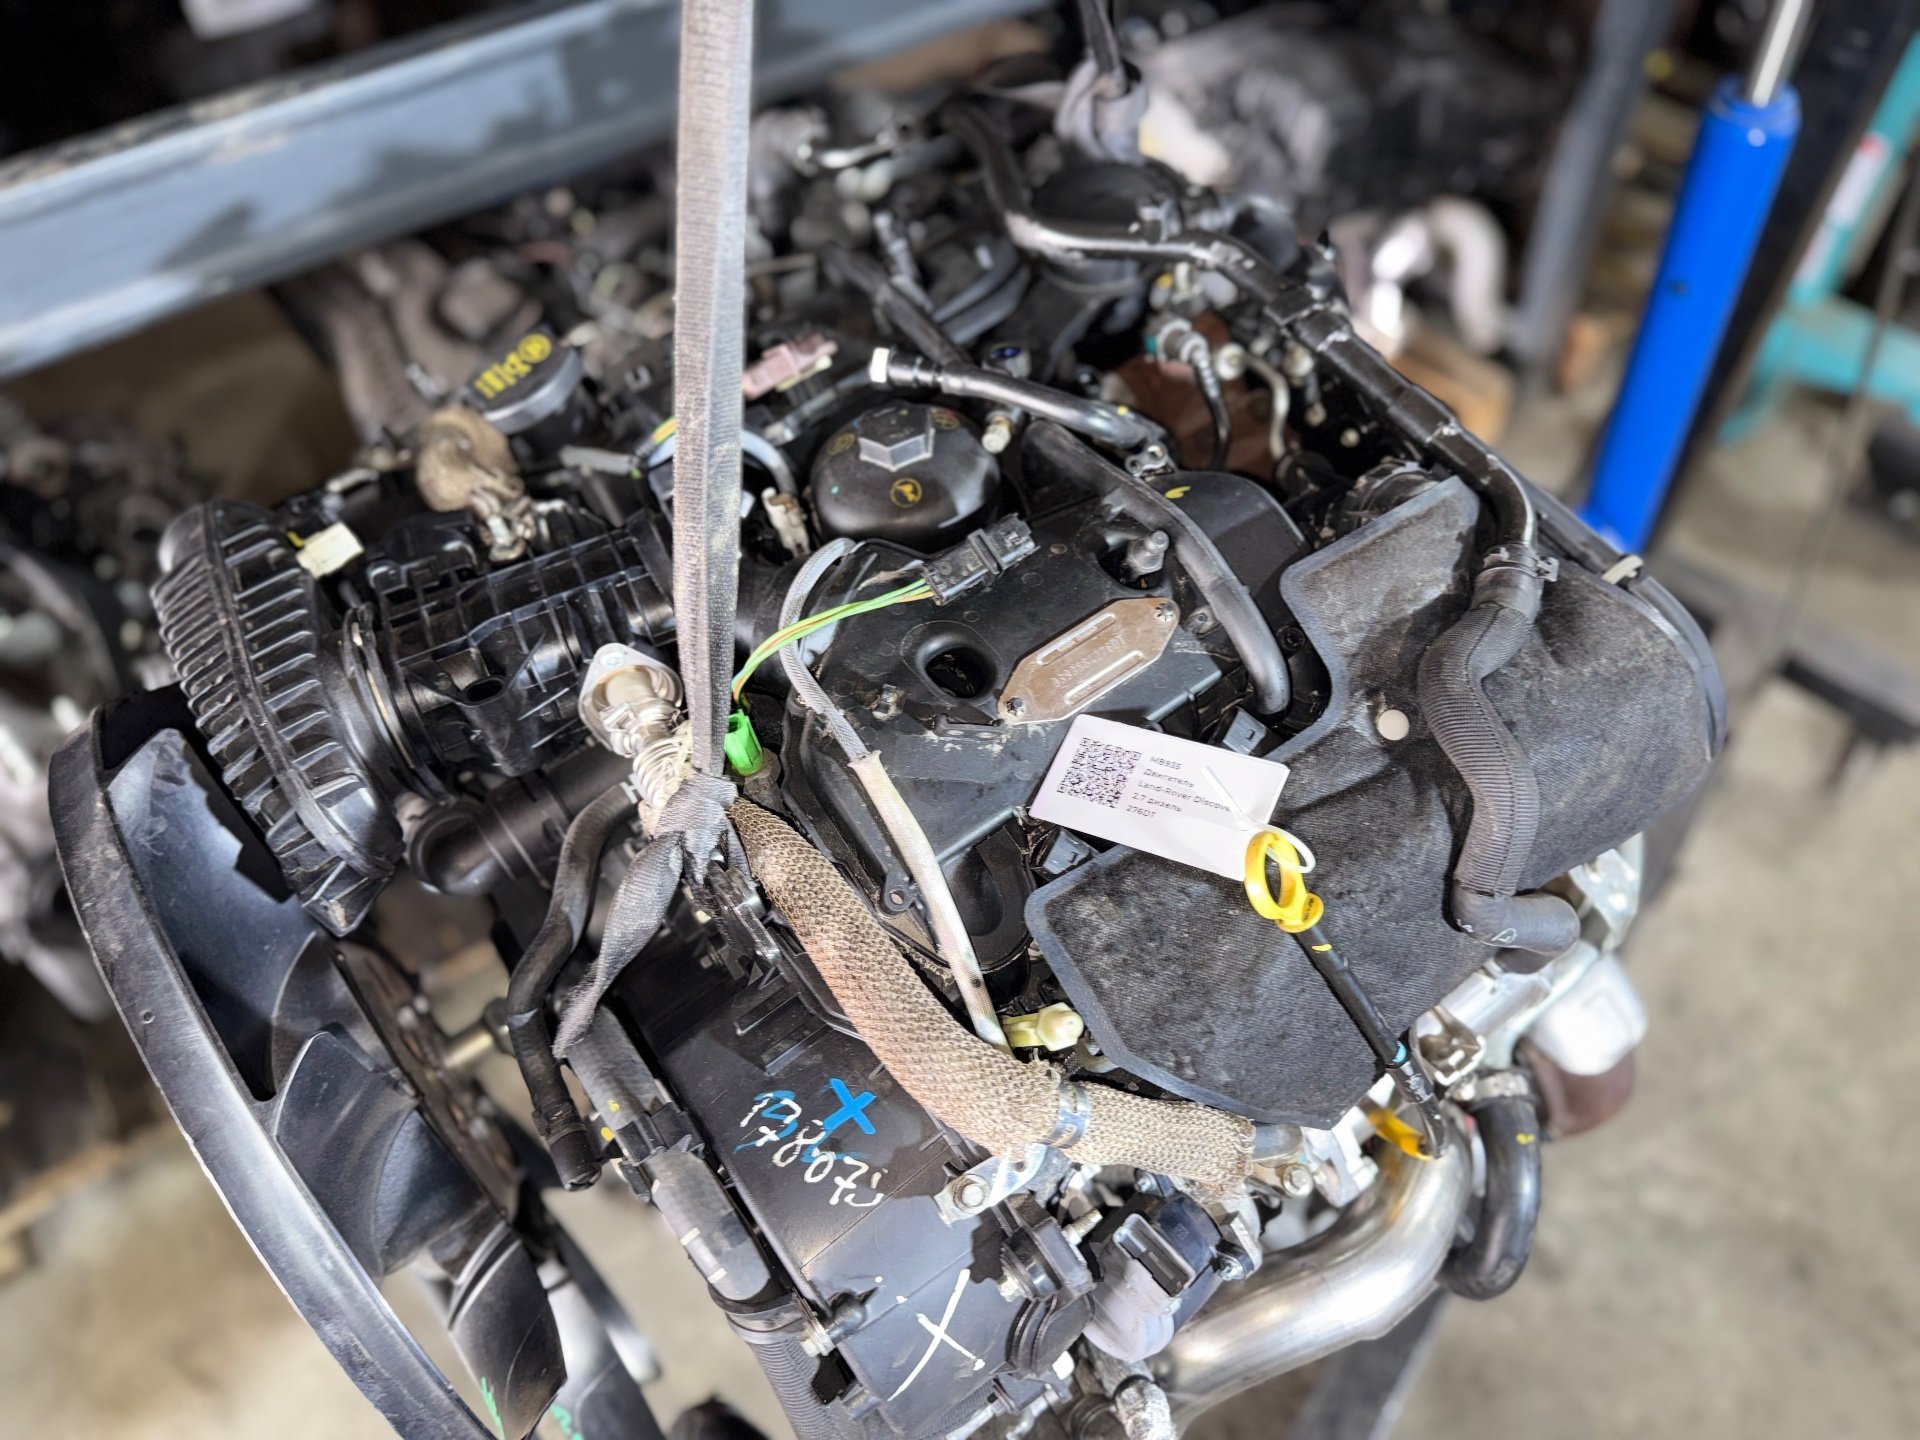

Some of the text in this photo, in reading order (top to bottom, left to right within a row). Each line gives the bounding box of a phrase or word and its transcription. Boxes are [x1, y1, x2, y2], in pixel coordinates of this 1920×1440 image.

[1144, 768, 1195, 788] Двигатель
[1139, 780, 1231, 812] Land-Rover Discove
[1126, 804, 1156, 818] 276DT
